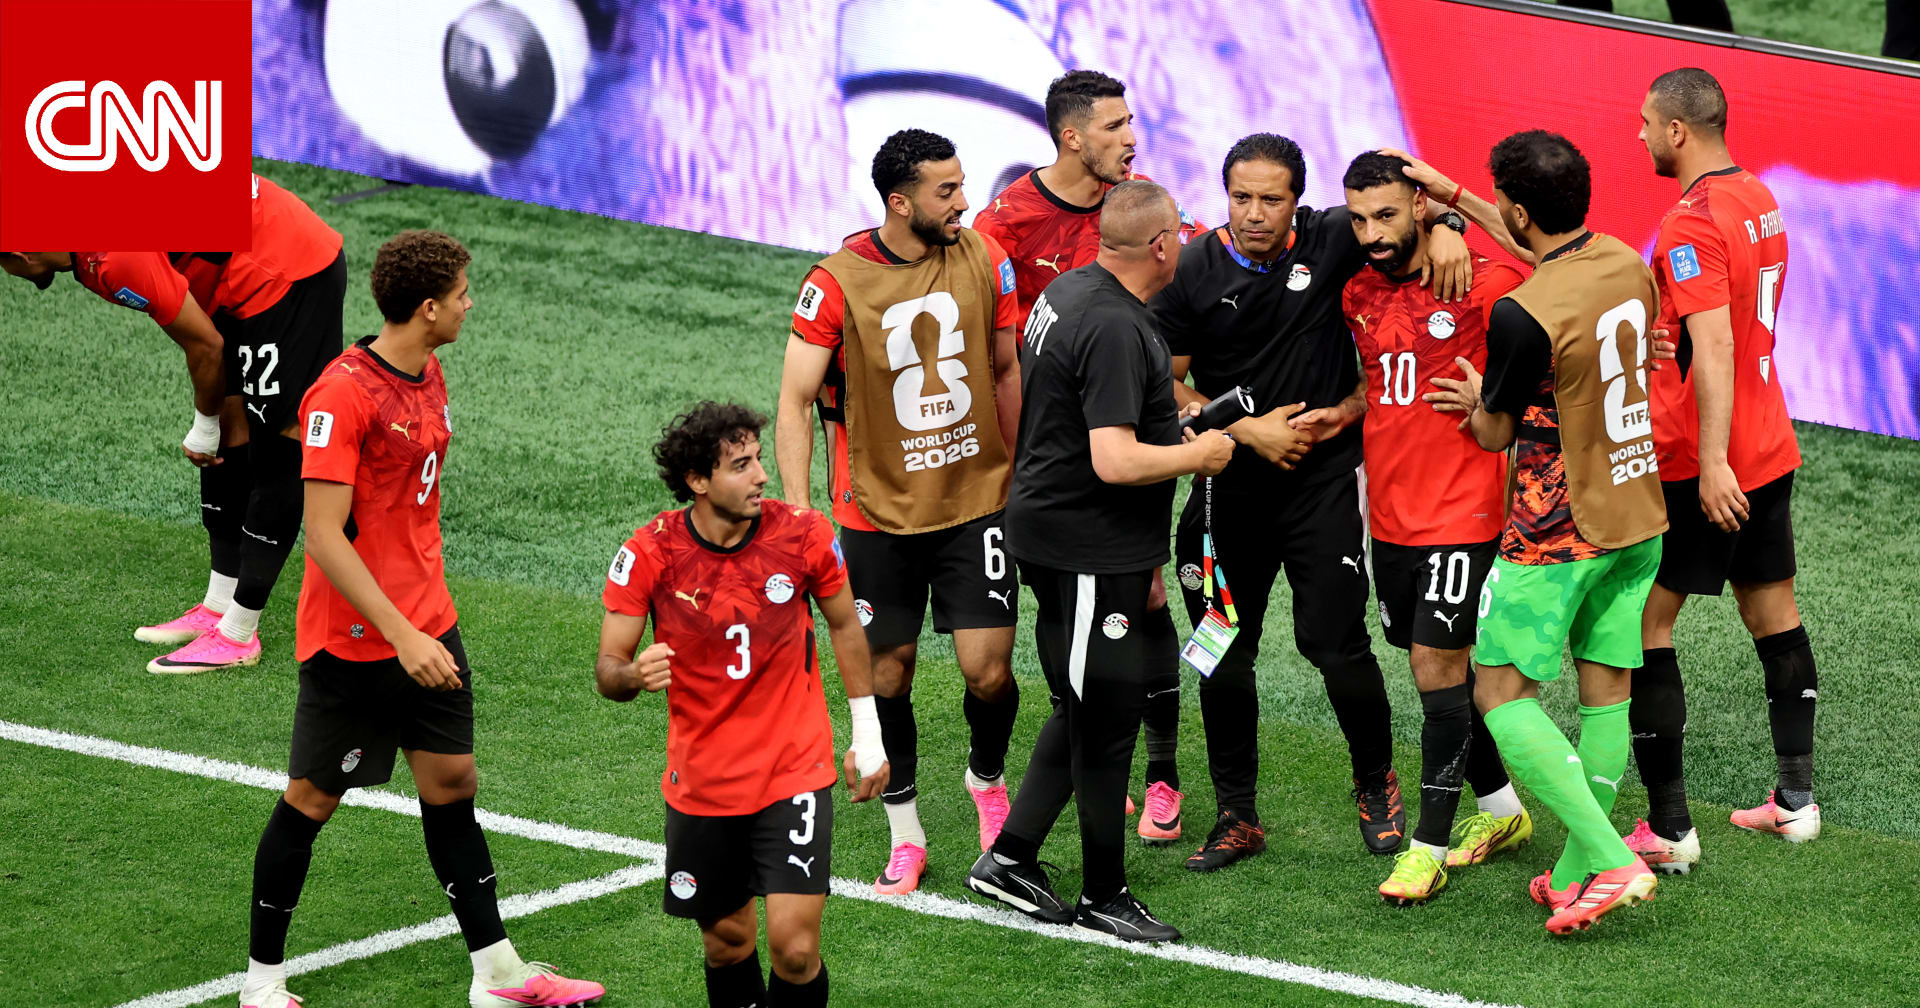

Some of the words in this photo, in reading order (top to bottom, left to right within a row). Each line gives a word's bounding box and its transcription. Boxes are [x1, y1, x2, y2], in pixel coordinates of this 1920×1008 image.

[1024, 291, 1059, 356] GYPT
[238, 343, 280, 396] 22
[1378, 351, 1416, 406] 10
[919, 399, 955, 418] FIFA
[901, 432, 952, 451] WORLD
[952, 423, 977, 440] CUP
[903, 437, 980, 472] 2026
[1608, 440, 1654, 465] WORLD
[417, 450, 437, 506] 9
[1610, 452, 1659, 486] 202
[983, 526, 1006, 581] 6
[1424, 551, 1471, 605] 10
[725, 623, 751, 680] 3
[788, 791, 817, 846] 3
